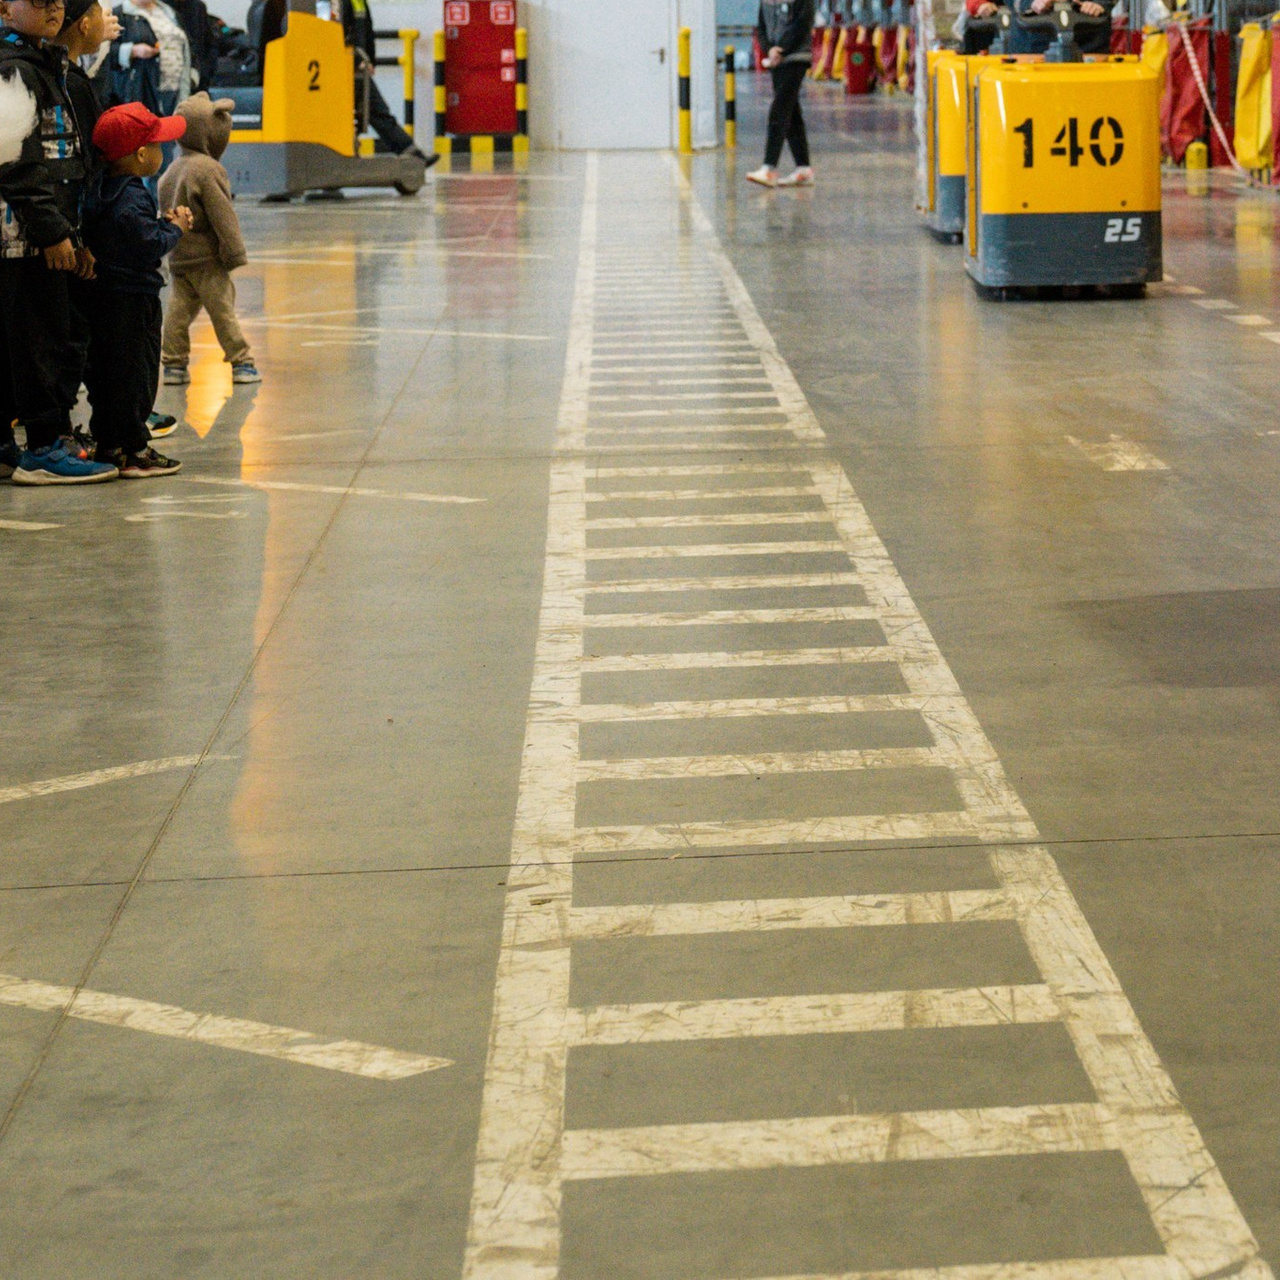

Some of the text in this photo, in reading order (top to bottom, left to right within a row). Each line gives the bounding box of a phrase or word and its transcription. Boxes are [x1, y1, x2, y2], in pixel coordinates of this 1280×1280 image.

[308, 60, 321, 91] 2
[1013, 116, 1125, 169] 140
[1103, 218, 1142, 243] 25
